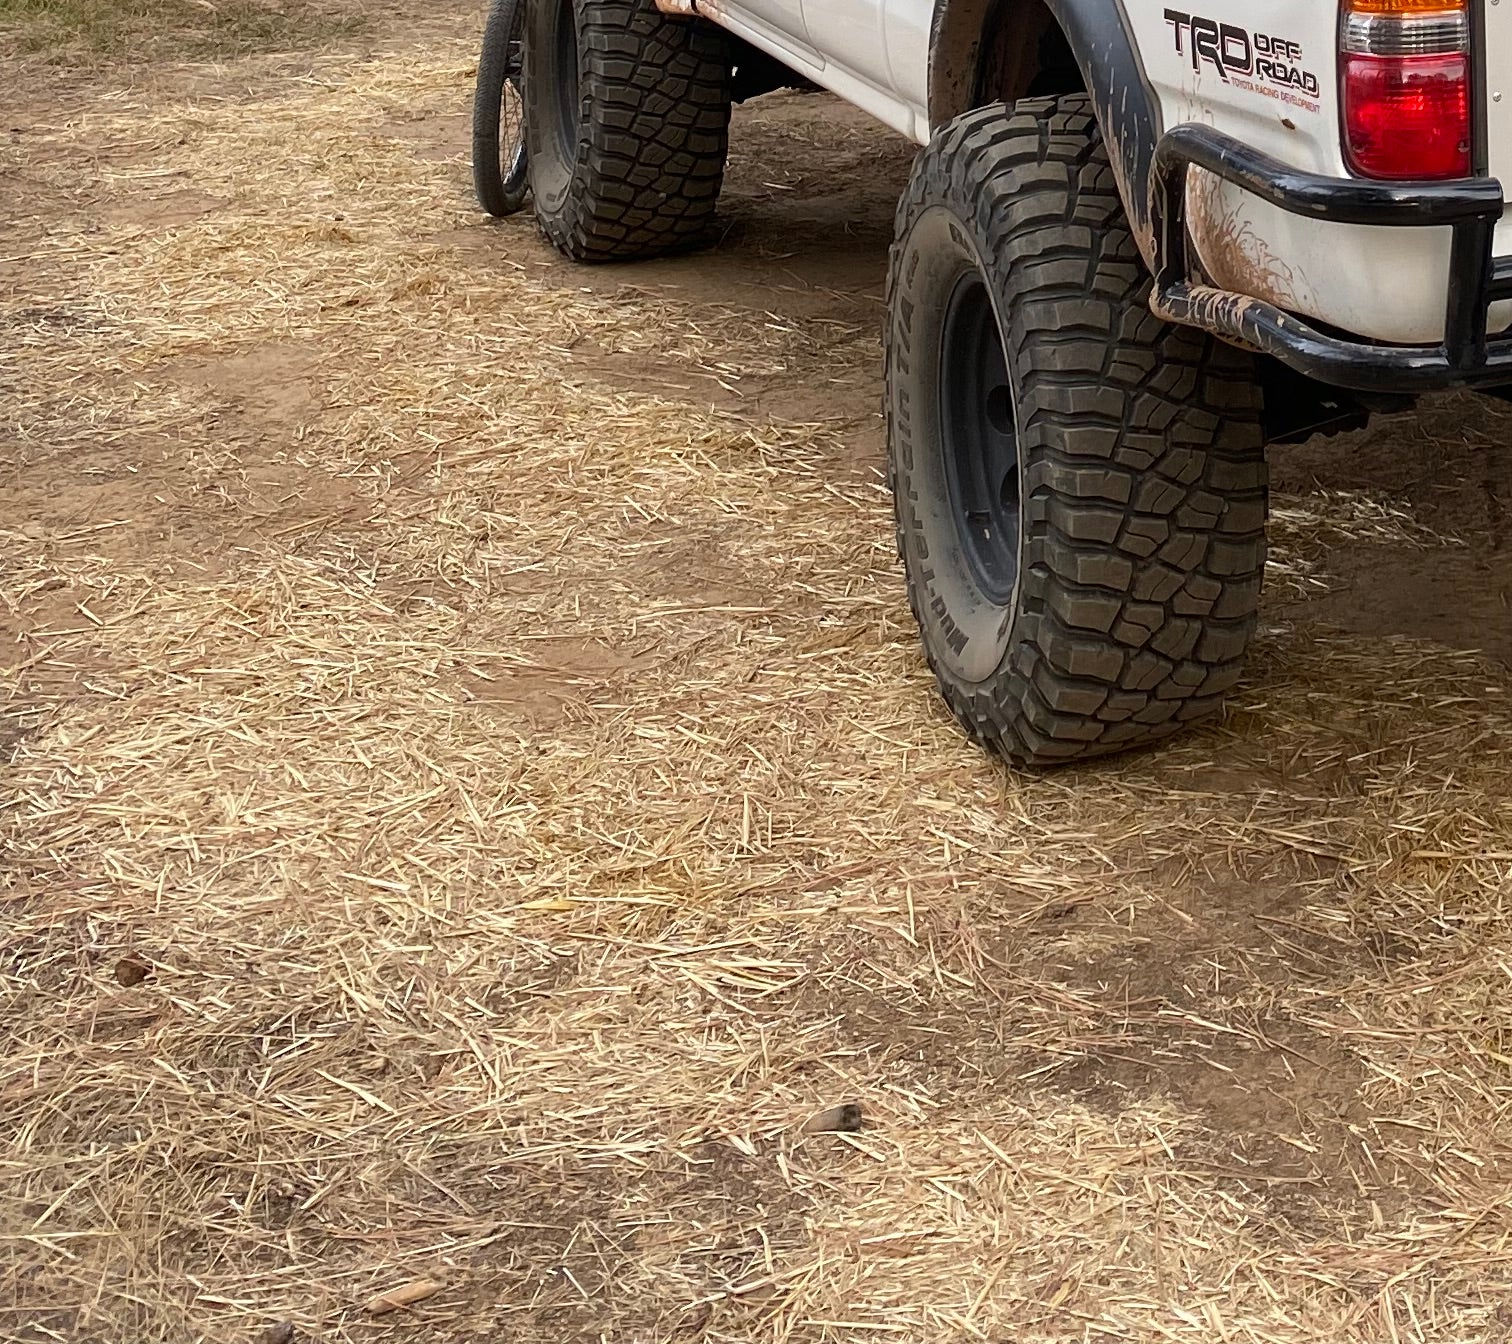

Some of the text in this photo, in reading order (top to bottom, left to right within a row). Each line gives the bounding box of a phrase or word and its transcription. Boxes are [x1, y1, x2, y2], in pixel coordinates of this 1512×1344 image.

[1163, 8, 1253, 83] TRD
[1254, 32, 1302, 62] OFF
[1256, 57, 1320, 99] ROAD
